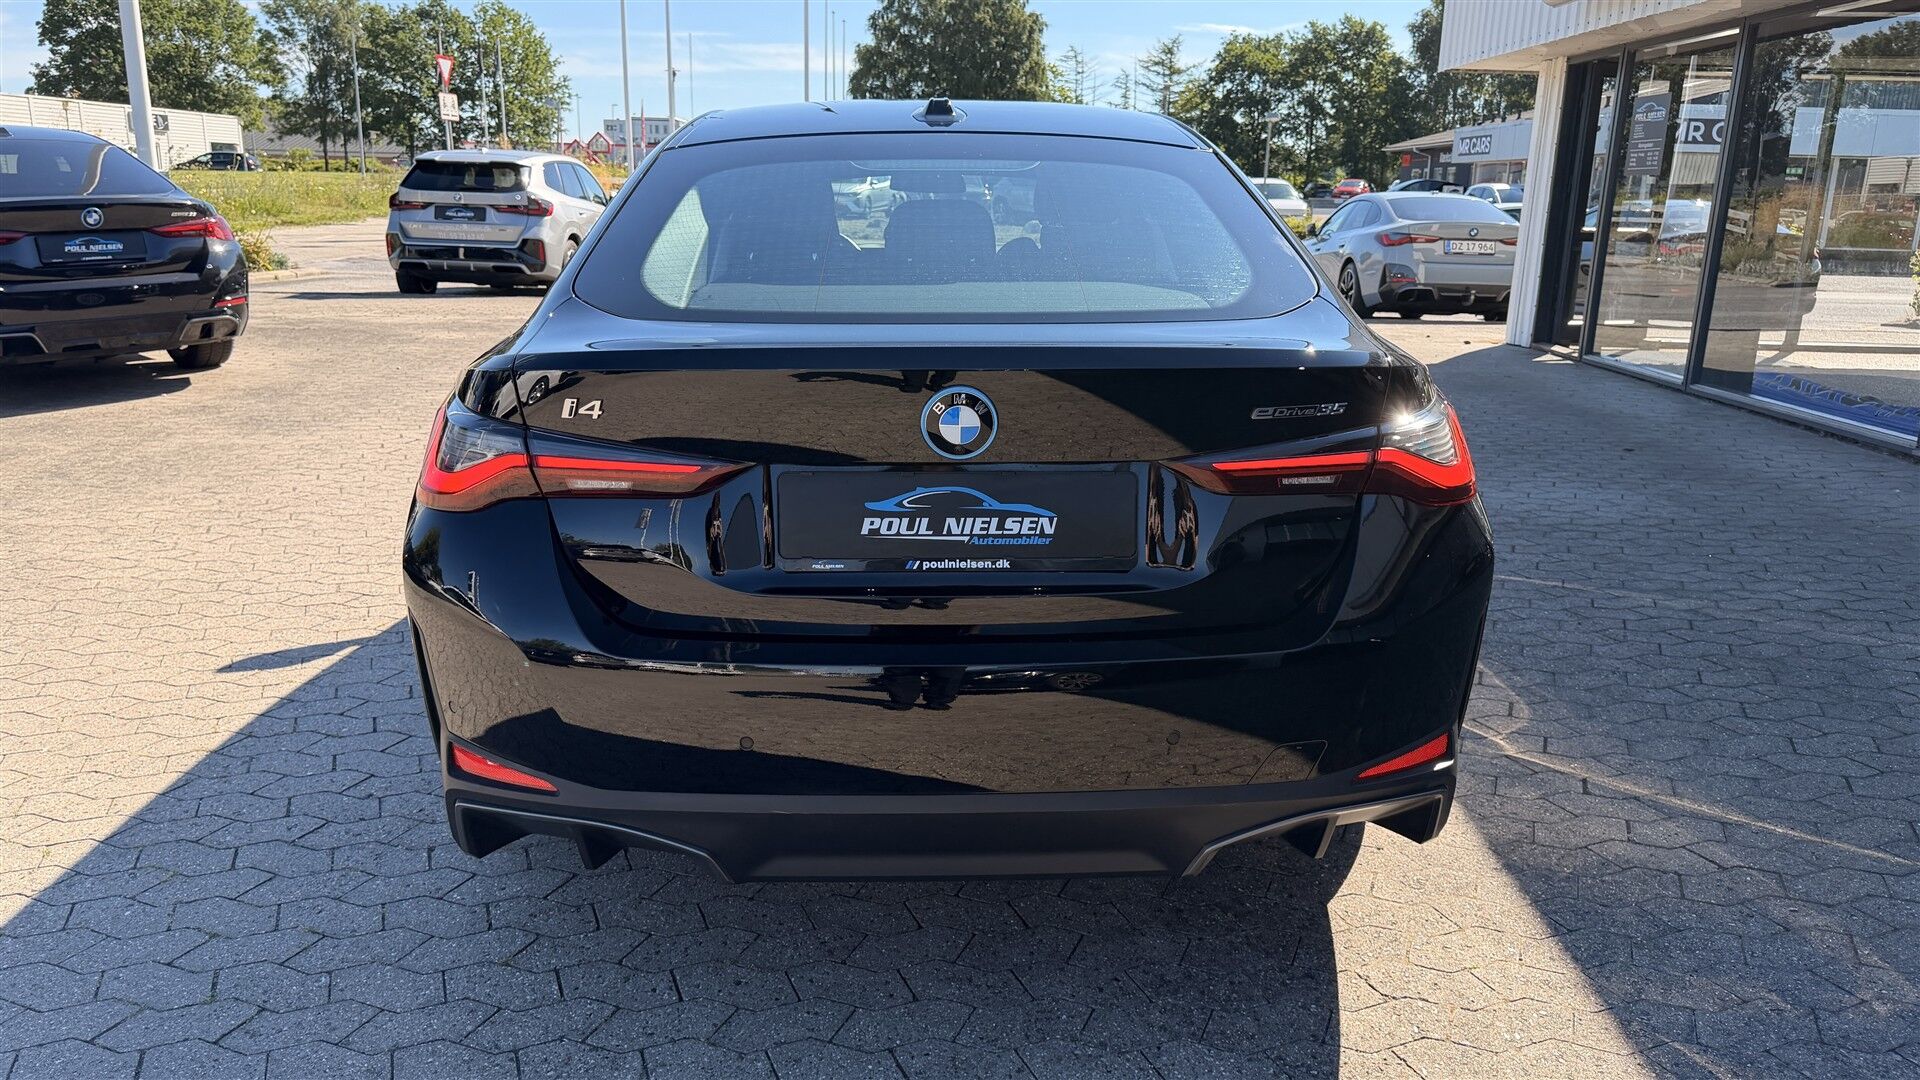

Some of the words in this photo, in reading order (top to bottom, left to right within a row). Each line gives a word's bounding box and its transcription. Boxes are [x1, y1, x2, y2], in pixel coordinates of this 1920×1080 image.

[1460, 138, 1470, 154] MR
[1470, 136, 1491, 153] CARS
[64, 243, 86, 252] POUL
[89, 242, 124, 252] NIELSEN
[1452, 242, 1463, 251] DZ
[1466, 242, 1476, 251] 17
[1477, 243, 1494, 251] 964
[561, 398, 603, 420] i4
[932, 393, 988, 416] BMW
[861, 517, 933, 535] POUL
[942, 517, 1057, 535] NIELSEN
[969, 535, 1053, 545] Automobiler
[922, 558, 1011, 570] poulnielsen.dk
